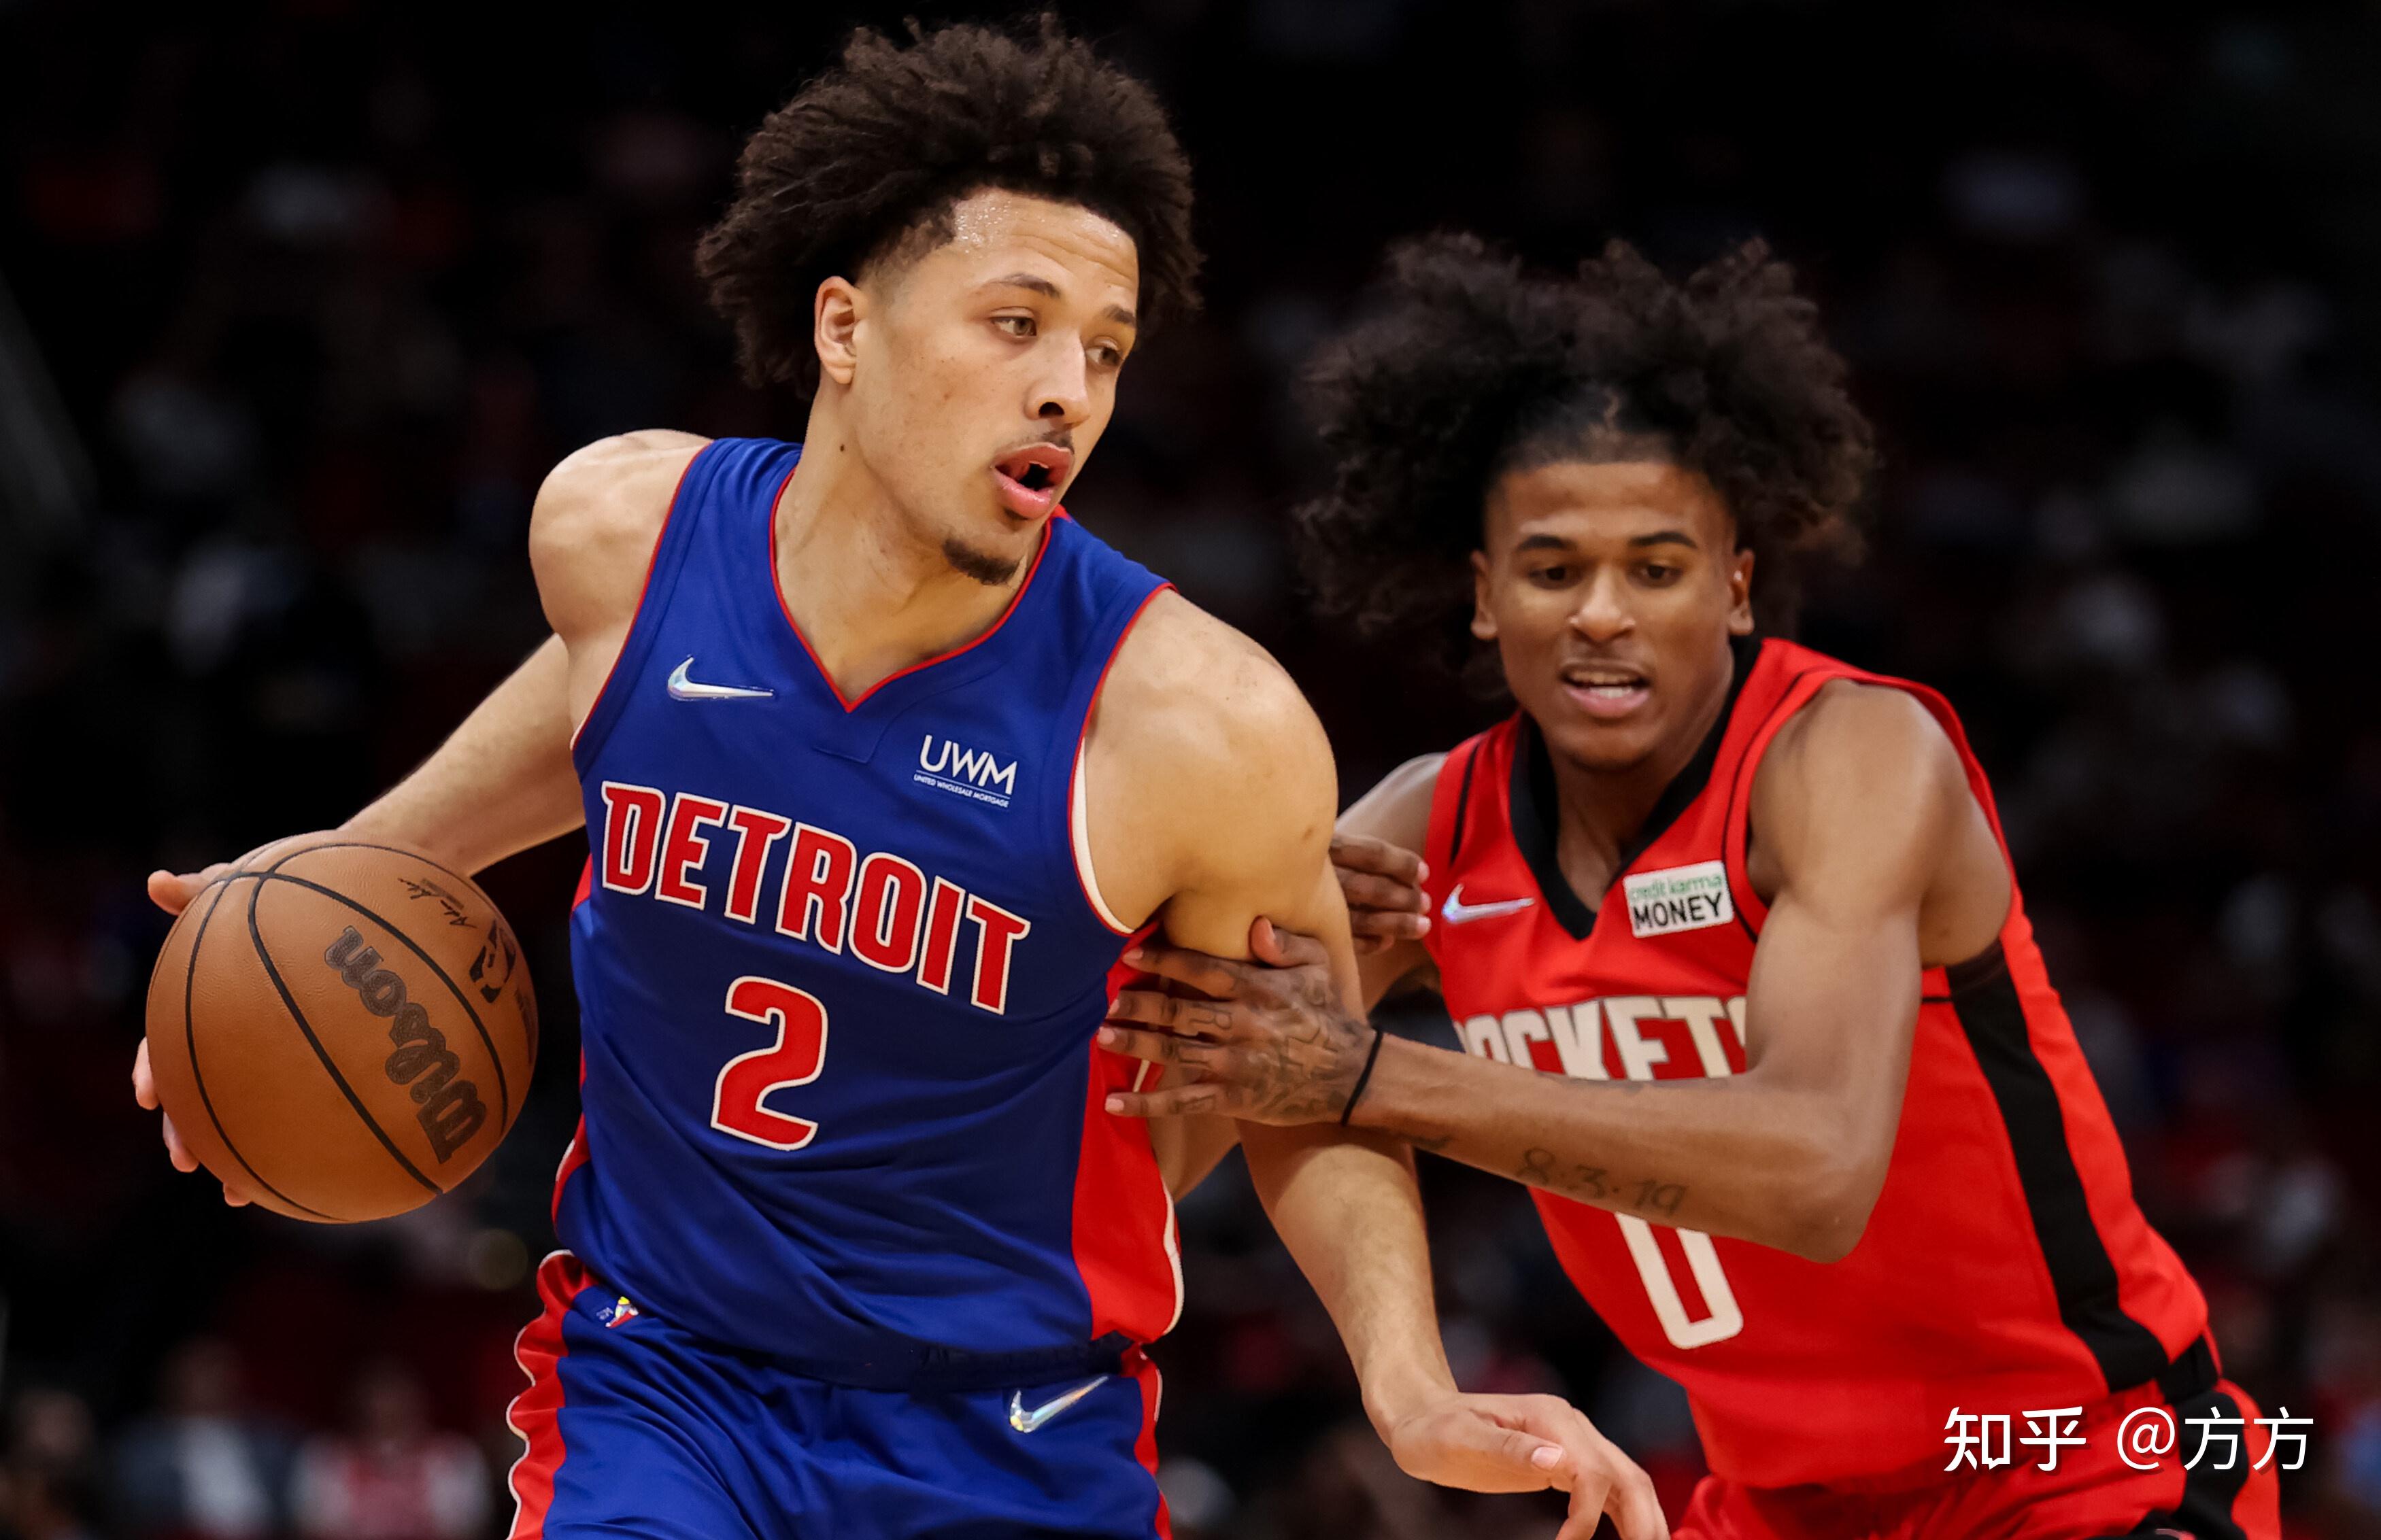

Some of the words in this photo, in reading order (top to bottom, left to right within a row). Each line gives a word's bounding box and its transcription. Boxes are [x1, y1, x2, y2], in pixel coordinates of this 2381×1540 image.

[913, 773, 937, 787] UNITED
[936, 780, 973, 798] WHOLESALE
[972, 791, 1010, 808] MORTGAGE
[919, 734, 1018, 795] UWM
[602, 781, 1031, 1015] DETROIT
[1634, 892, 1722, 930] MONEY
[324, 925, 486, 1165] Wilson
[710, 975, 828, 1152] 2
[1451, 995, 1746, 1082] OCKET
